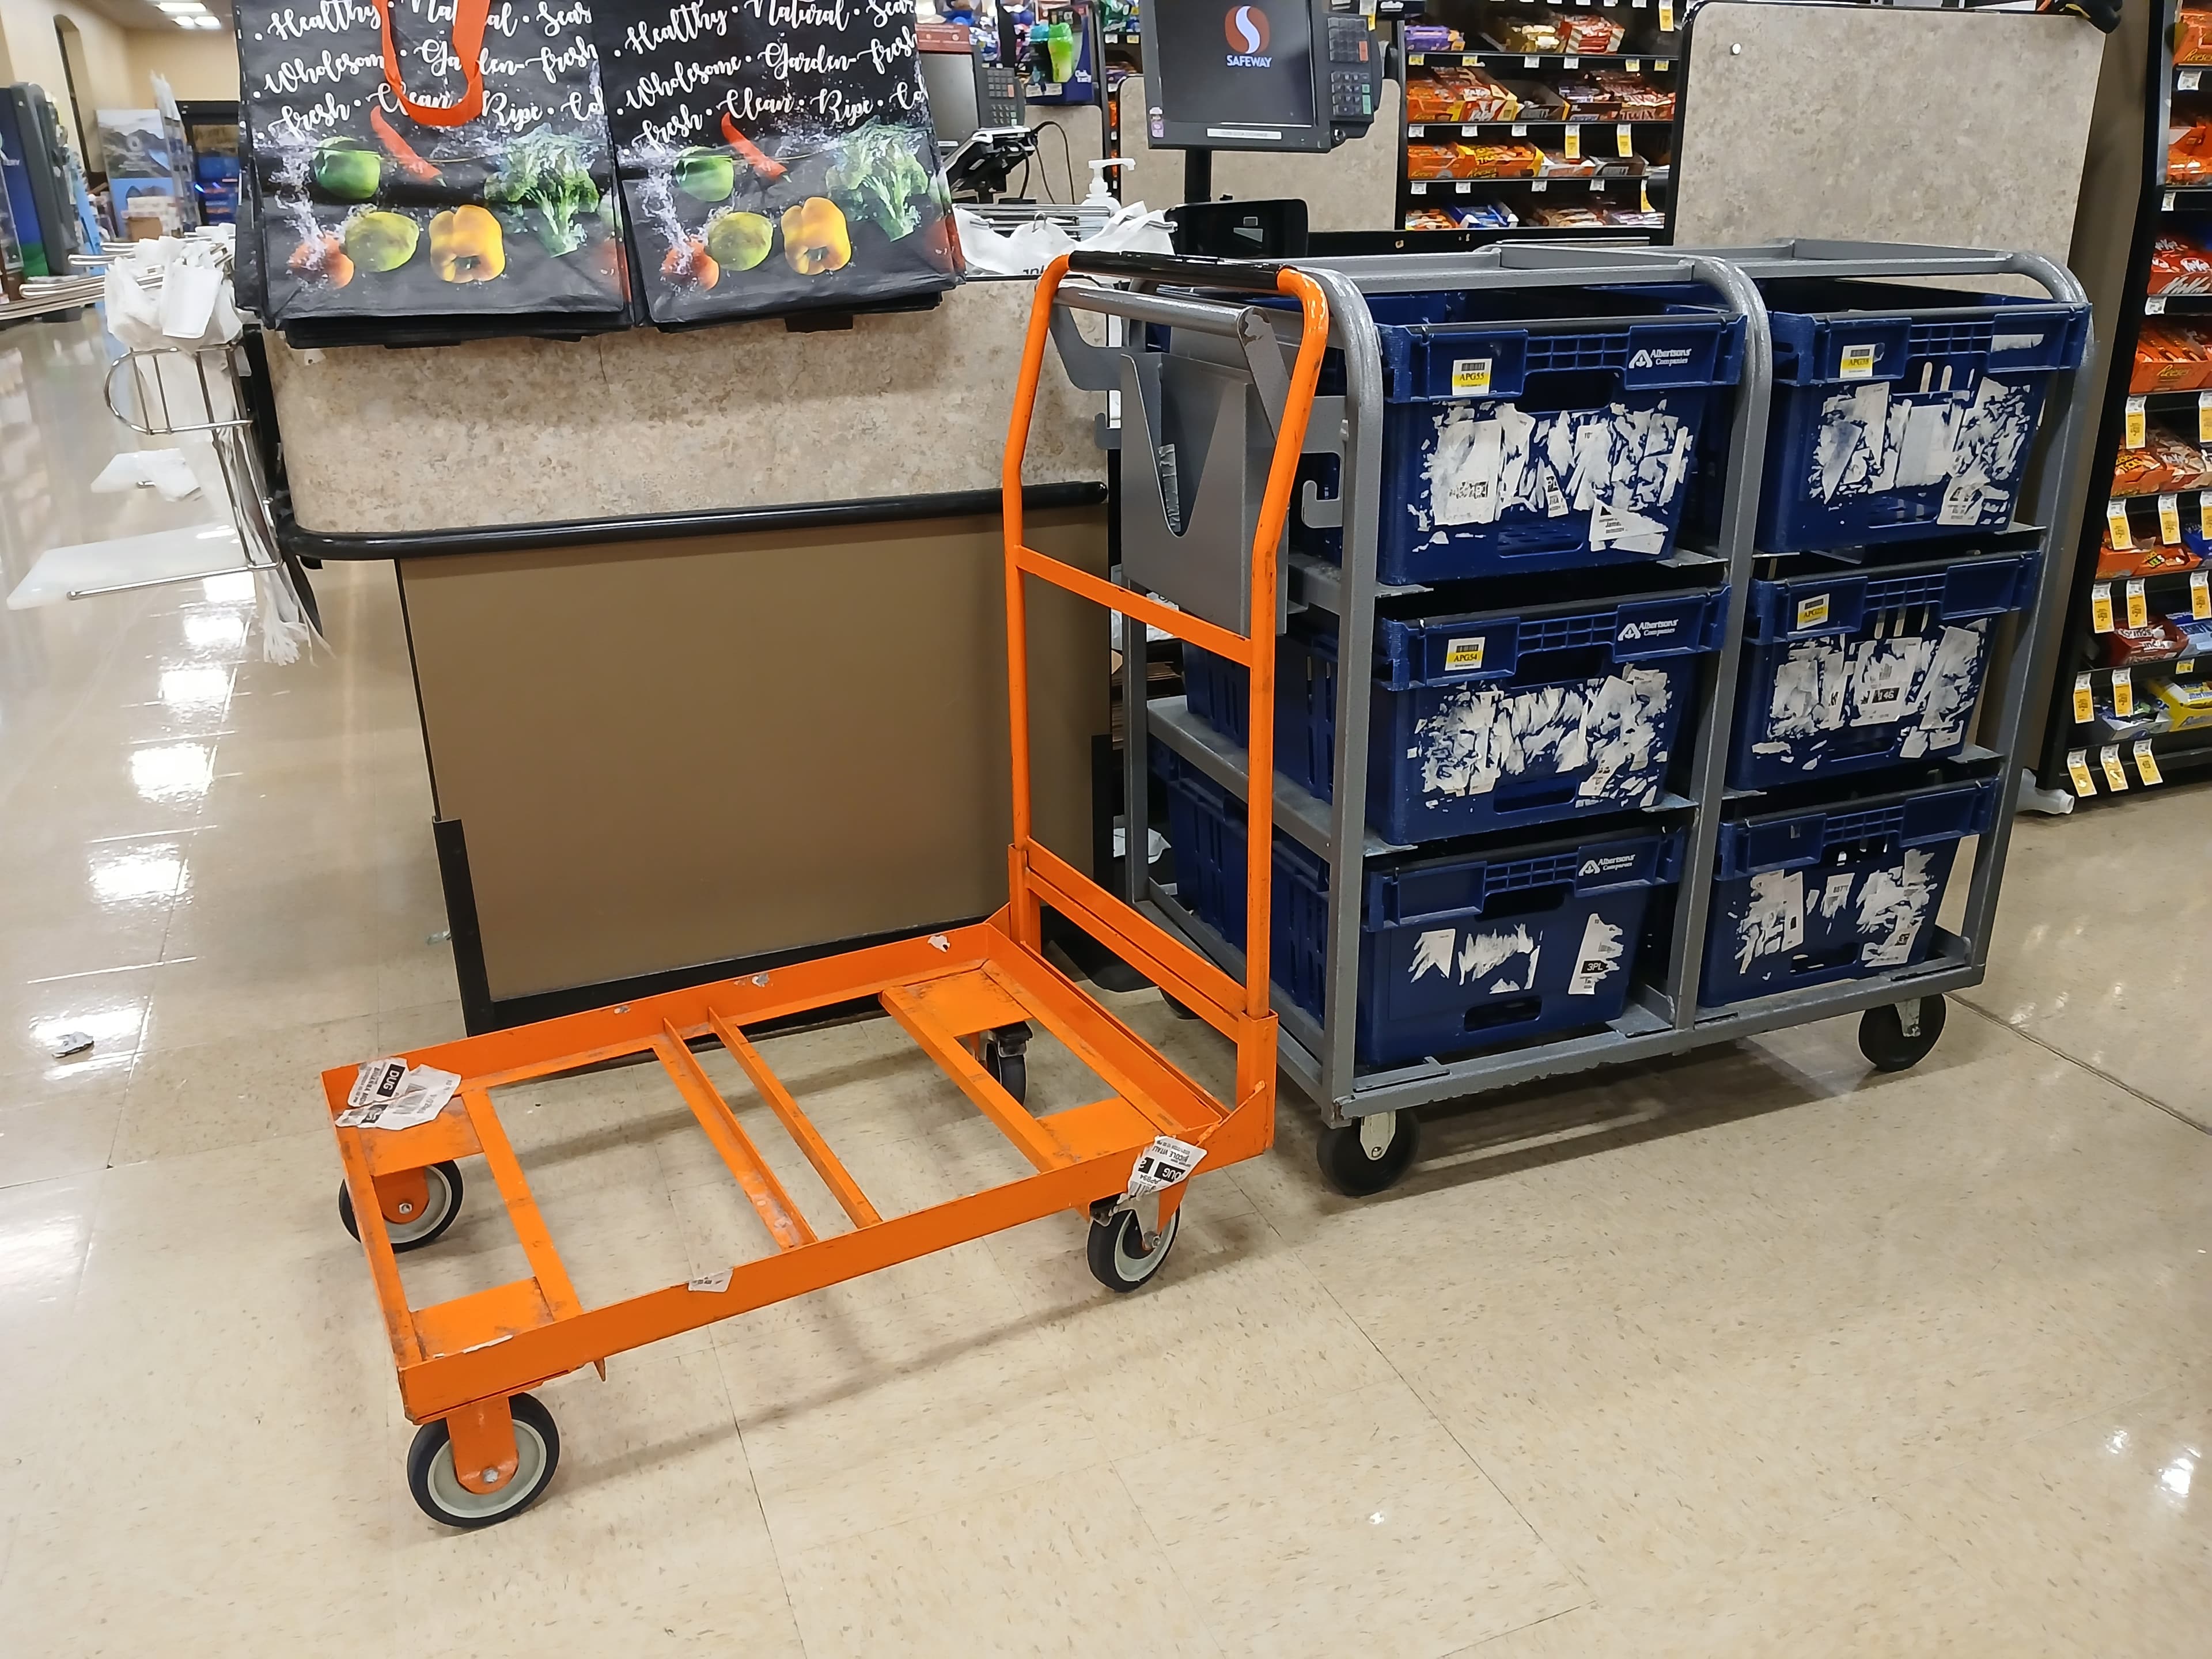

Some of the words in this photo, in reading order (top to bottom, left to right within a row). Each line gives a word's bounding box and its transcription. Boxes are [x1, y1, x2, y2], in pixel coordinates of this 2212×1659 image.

[267, 0, 381, 40] Healthy
[624, 0, 728, 55] Healthy
[744, 0, 850, 31] Natural
[264, 50, 385, 94] Wholesom
[1226, 55, 1272, 67] SAFEWAY
[626, 61, 742, 109] Wholesome
[268, 92, 350, 142] fresh
[482, 90, 543, 132] Ripe
[631, 104, 703, 154] fresh
[715, 87, 794, 121] Clean
[809, 88, 874, 126] Ripe
[1460, 372, 1484, 381] APG55
[1453, 653, 1478, 662] APG54
[1586, 963, 1604, 971] 3PL
[382, 1069, 400, 1092] DUG
[1139, 1173, 1159, 1185] APB94
